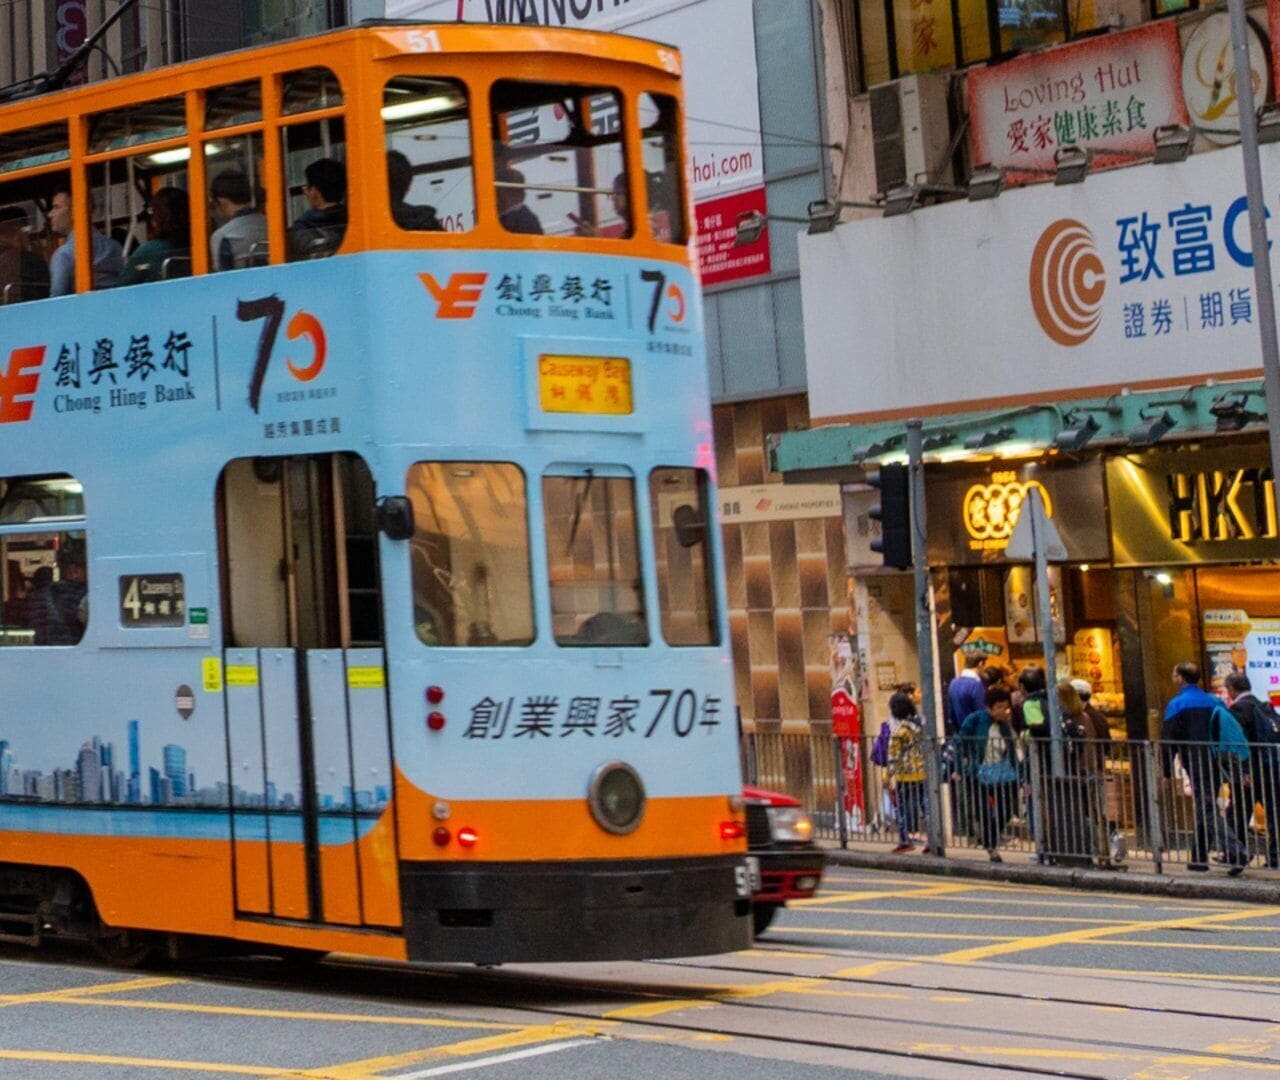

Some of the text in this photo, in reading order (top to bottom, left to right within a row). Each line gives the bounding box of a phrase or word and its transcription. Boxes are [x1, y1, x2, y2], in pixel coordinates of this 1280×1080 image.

[403, 29, 441, 53] 51
[1004, 59, 1141, 112] Loving Hut
[1006, 94, 1148, 154] 愛家健康素食
[692, 152, 753, 183] hai.com
[1116, 196, 1275, 284] 致富 C
[496, 304, 540, 318] Chong
[585, 308, 615, 320] Bank
[1123, 287, 1253, 339] 證券 期貨
[53, 331, 194, 388] 創興銀行
[53, 383, 196, 414] Chong Hing Bank
[1167, 468, 1278, 542] HKT
[123, 578, 140, 620] 4
[463, 689, 722, 739] 創業興家70年
